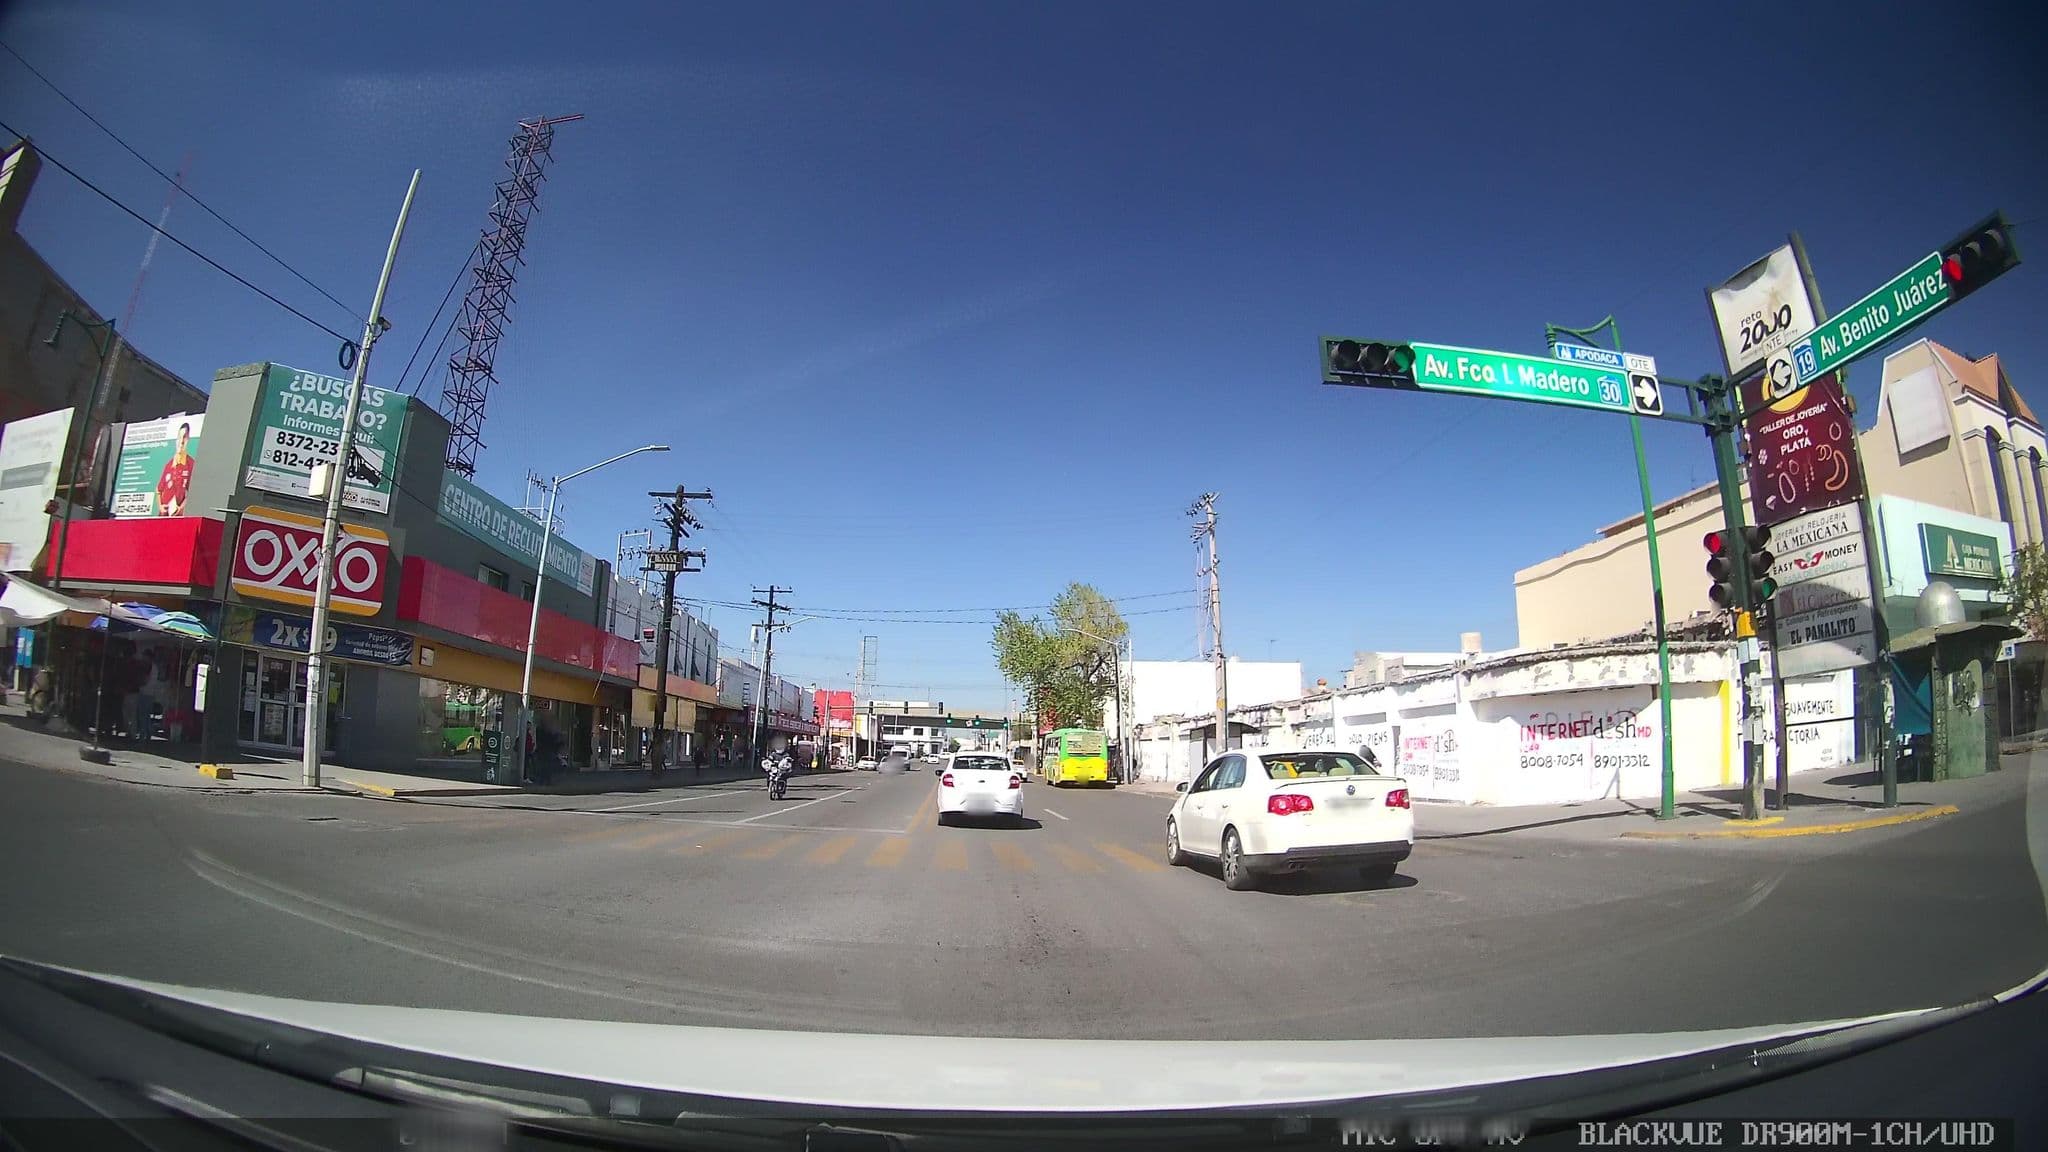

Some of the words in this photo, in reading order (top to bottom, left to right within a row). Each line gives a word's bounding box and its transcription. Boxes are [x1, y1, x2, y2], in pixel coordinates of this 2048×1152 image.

[1741, 310, 1762, 328] reto
[1820, 335, 1841, 361] Av.
[1839, 304, 1890, 351] Benito
[1893, 268, 1948, 317] Juárez
[1574, 348, 1619, 365] APODACA
[1630, 357, 1650, 371] OTE
[1797, 352, 1815, 375] 19
[1424, 353, 1454, 379] Av.
[1518, 364, 1590, 396] Madero
[1600, 381, 1621, 403] 30
[279, 391, 388, 431] TRABAO?
[1785, 414, 1796, 426] DE
[283, 414, 340, 437] Informes
[1782, 424, 1804, 440] ORO
[1780, 436, 1812, 457] PLATA
[443, 484, 491, 531] CENTRO
[491, 510, 508, 543] DE
[507, 522, 579, 579] RECLUTMIENTO
[1808, 511, 1847, 529] RELOJERIA
[1776, 540, 1789, 554] LA
[1792, 520, 1849, 547] MEXICANA
[244, 529, 378, 593] OXXO
[1772, 561, 1793, 576] EASY
[1824, 542, 1859, 561] MONEY
[270, 618, 300, 649] 2x
[302, 626, 338, 652] $9
[1520, 719, 1593, 742] INTERNET
